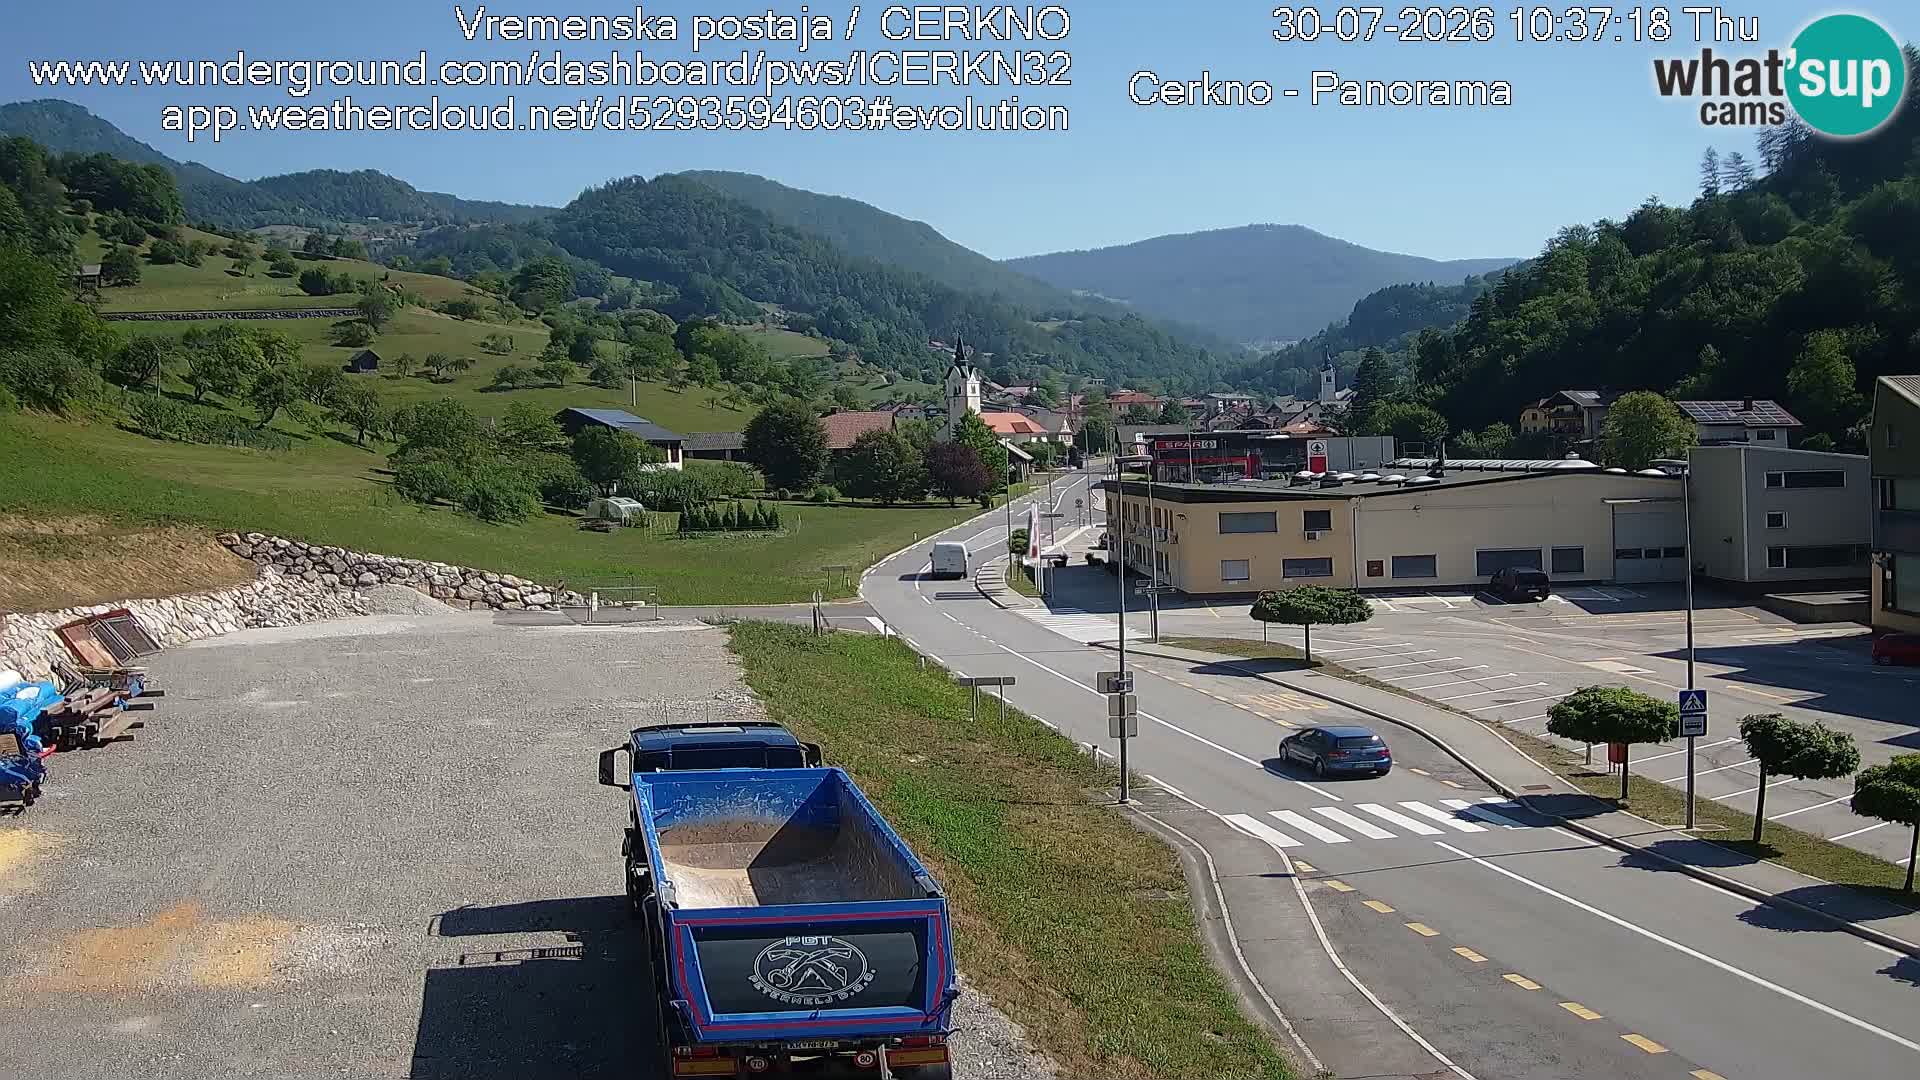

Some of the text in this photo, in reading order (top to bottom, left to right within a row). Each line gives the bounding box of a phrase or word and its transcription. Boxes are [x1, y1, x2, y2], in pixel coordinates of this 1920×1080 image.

[1165, 440, 1201, 449] SPAR
[747, 974, 834, 1005] PETERNELJ
[859, 1055, 871, 1063] 80
